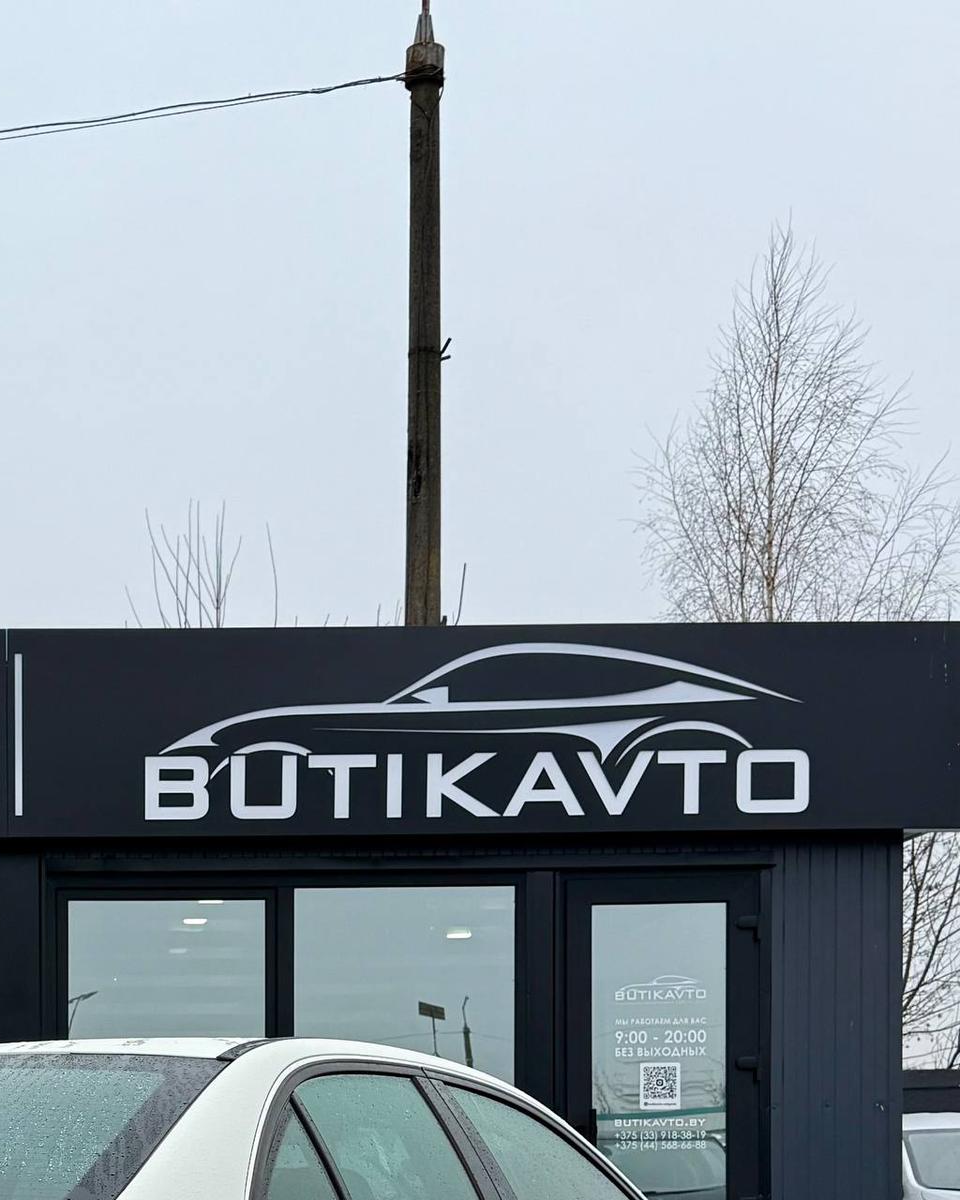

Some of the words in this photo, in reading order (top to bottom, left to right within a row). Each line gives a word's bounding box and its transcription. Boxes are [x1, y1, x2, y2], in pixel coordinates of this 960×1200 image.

[144, 748, 811, 821] BUTIKAVTO
[614, 989, 707, 1001] BUTIKAVTO
[615, 1031, 648, 1044] 9:00
[664, 1029, 707, 1044] 20:00
[615, 1047, 634, 1058] БЕЗ
[637, 1046, 707, 1057] ВЫХОДНЫХ
[614, 1118, 707, 1127] BUTIKAVTO.BY
[614, 1130, 638, 1140] +375
[640, 1130, 658, 1142] (33)
[660, 1130, 707, 1140] 918-38-19
[614, 1140, 638, 1150] +375
[640, 1140, 658, 1152] (44)
[661, 1140, 707, 1150] 568-66-88
